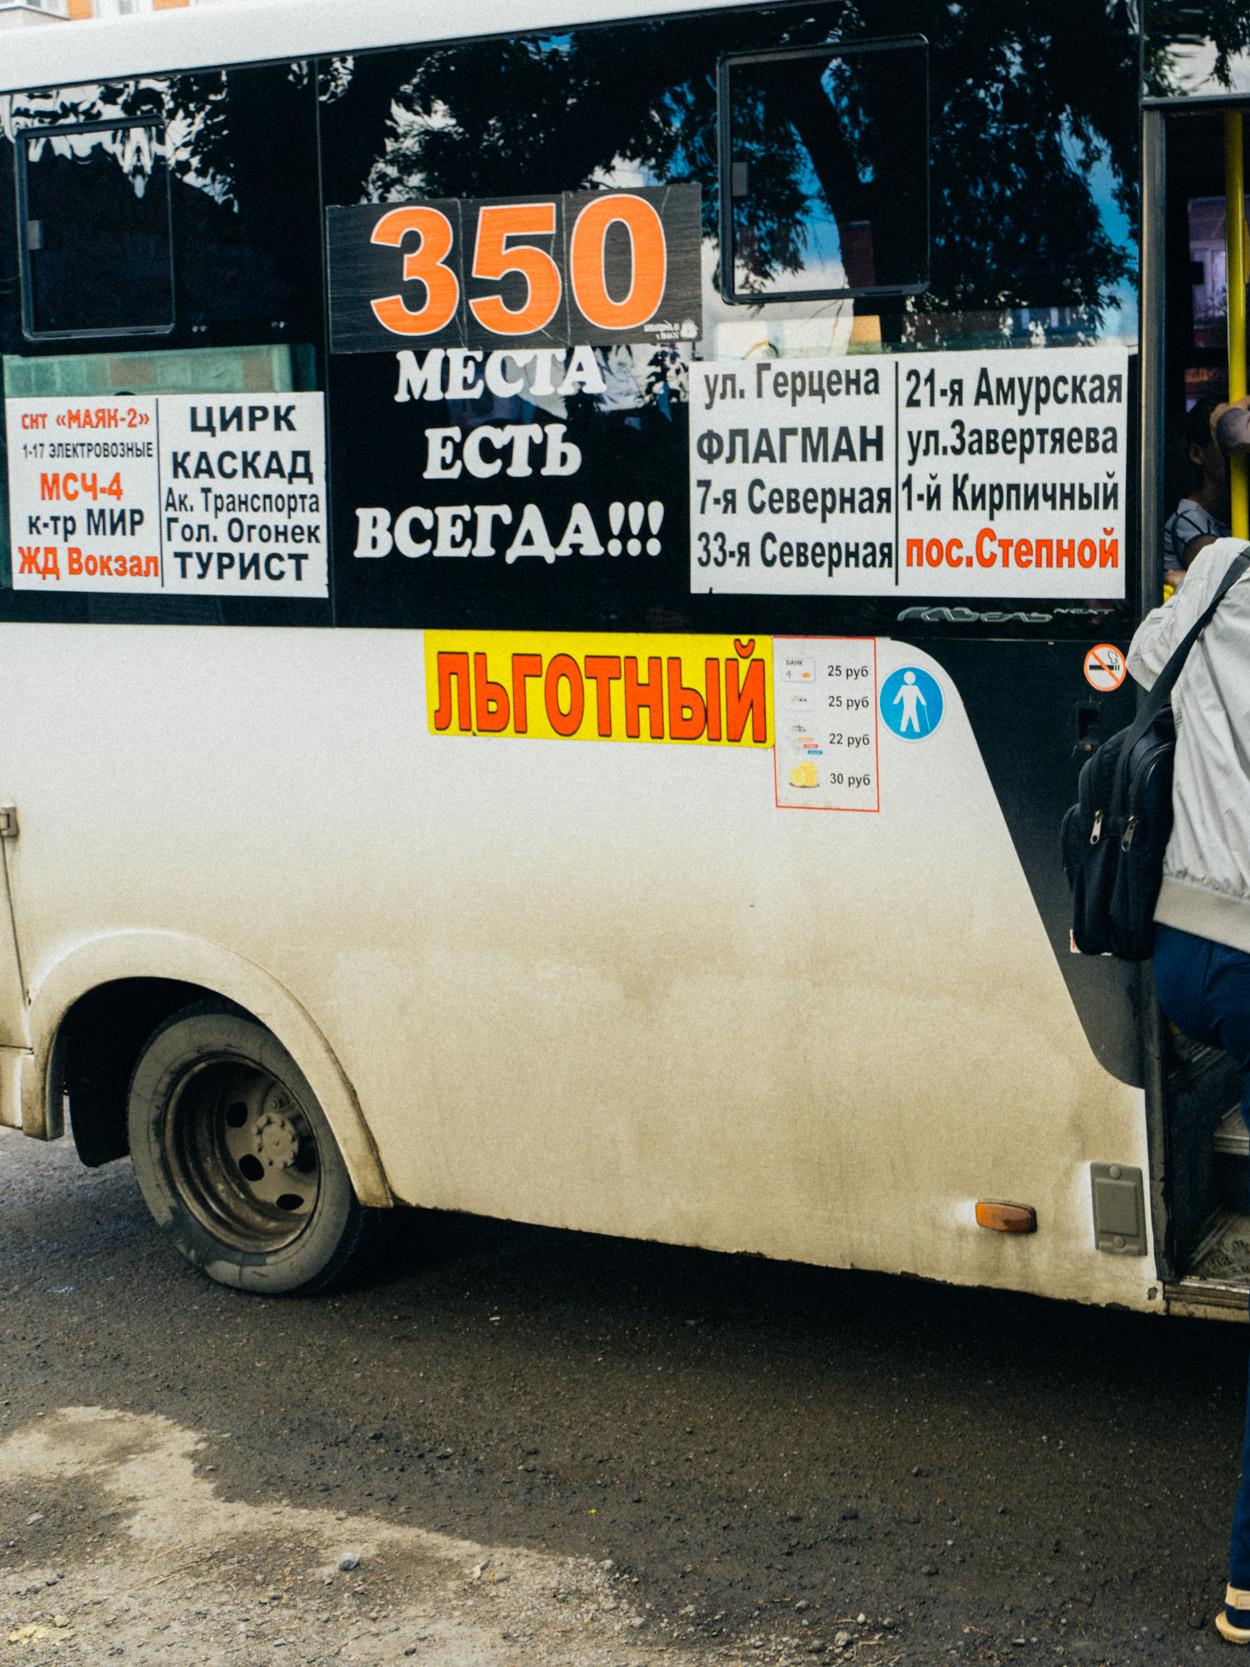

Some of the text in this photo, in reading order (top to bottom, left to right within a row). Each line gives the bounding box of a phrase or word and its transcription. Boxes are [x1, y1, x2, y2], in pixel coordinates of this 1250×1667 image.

[370, 194, 667, 336] 350
[395, 345, 607, 402] МЕСТА
[704, 363, 879, 410] ул. Герцена
[906, 367, 1122, 416] 21-я Амурская
[22, 408, 149, 429] СНТ «МАЯК-2»
[190, 405, 296, 437] ЦИРК
[23, 442, 153, 458] 1-17 ЭЛЕКТРОВОЗНЫЕ
[423, 424, 581, 478] ЕСТЬ
[697, 425, 883, 464] ФЛАГМАН
[907, 419, 1117, 466] ул.Завертяева
[172, 450, 313, 484] КАСКАД
[41, 472, 123, 501] МСЧ-4
[165, 487, 319, 518] Ак. Транспорта
[697, 479, 891, 523] 7-я Северная
[902, 472, 1118, 521] 1-й Кирпичный
[28, 509, 144, 542] к-тр МИР
[167, 518, 320, 543] Гол. Огонек
[354, 502, 663, 563] ВСЕГДА!!!
[18, 547, 160, 580] ЖД Вокзал
[698, 531, 893, 577] 33-я Северная
[906, 528, 1118, 569] пос.Степной
[173, 552, 309, 581] ТУРИСТ
[828, 665, 868, 680] 25 руб
[434, 638, 767, 743] ЛЬГОТНЫЙ
[829, 696, 869, 711] 25 руб
[829, 733, 870, 748] 22 руб
[830, 773, 870, 788] 30 руб
